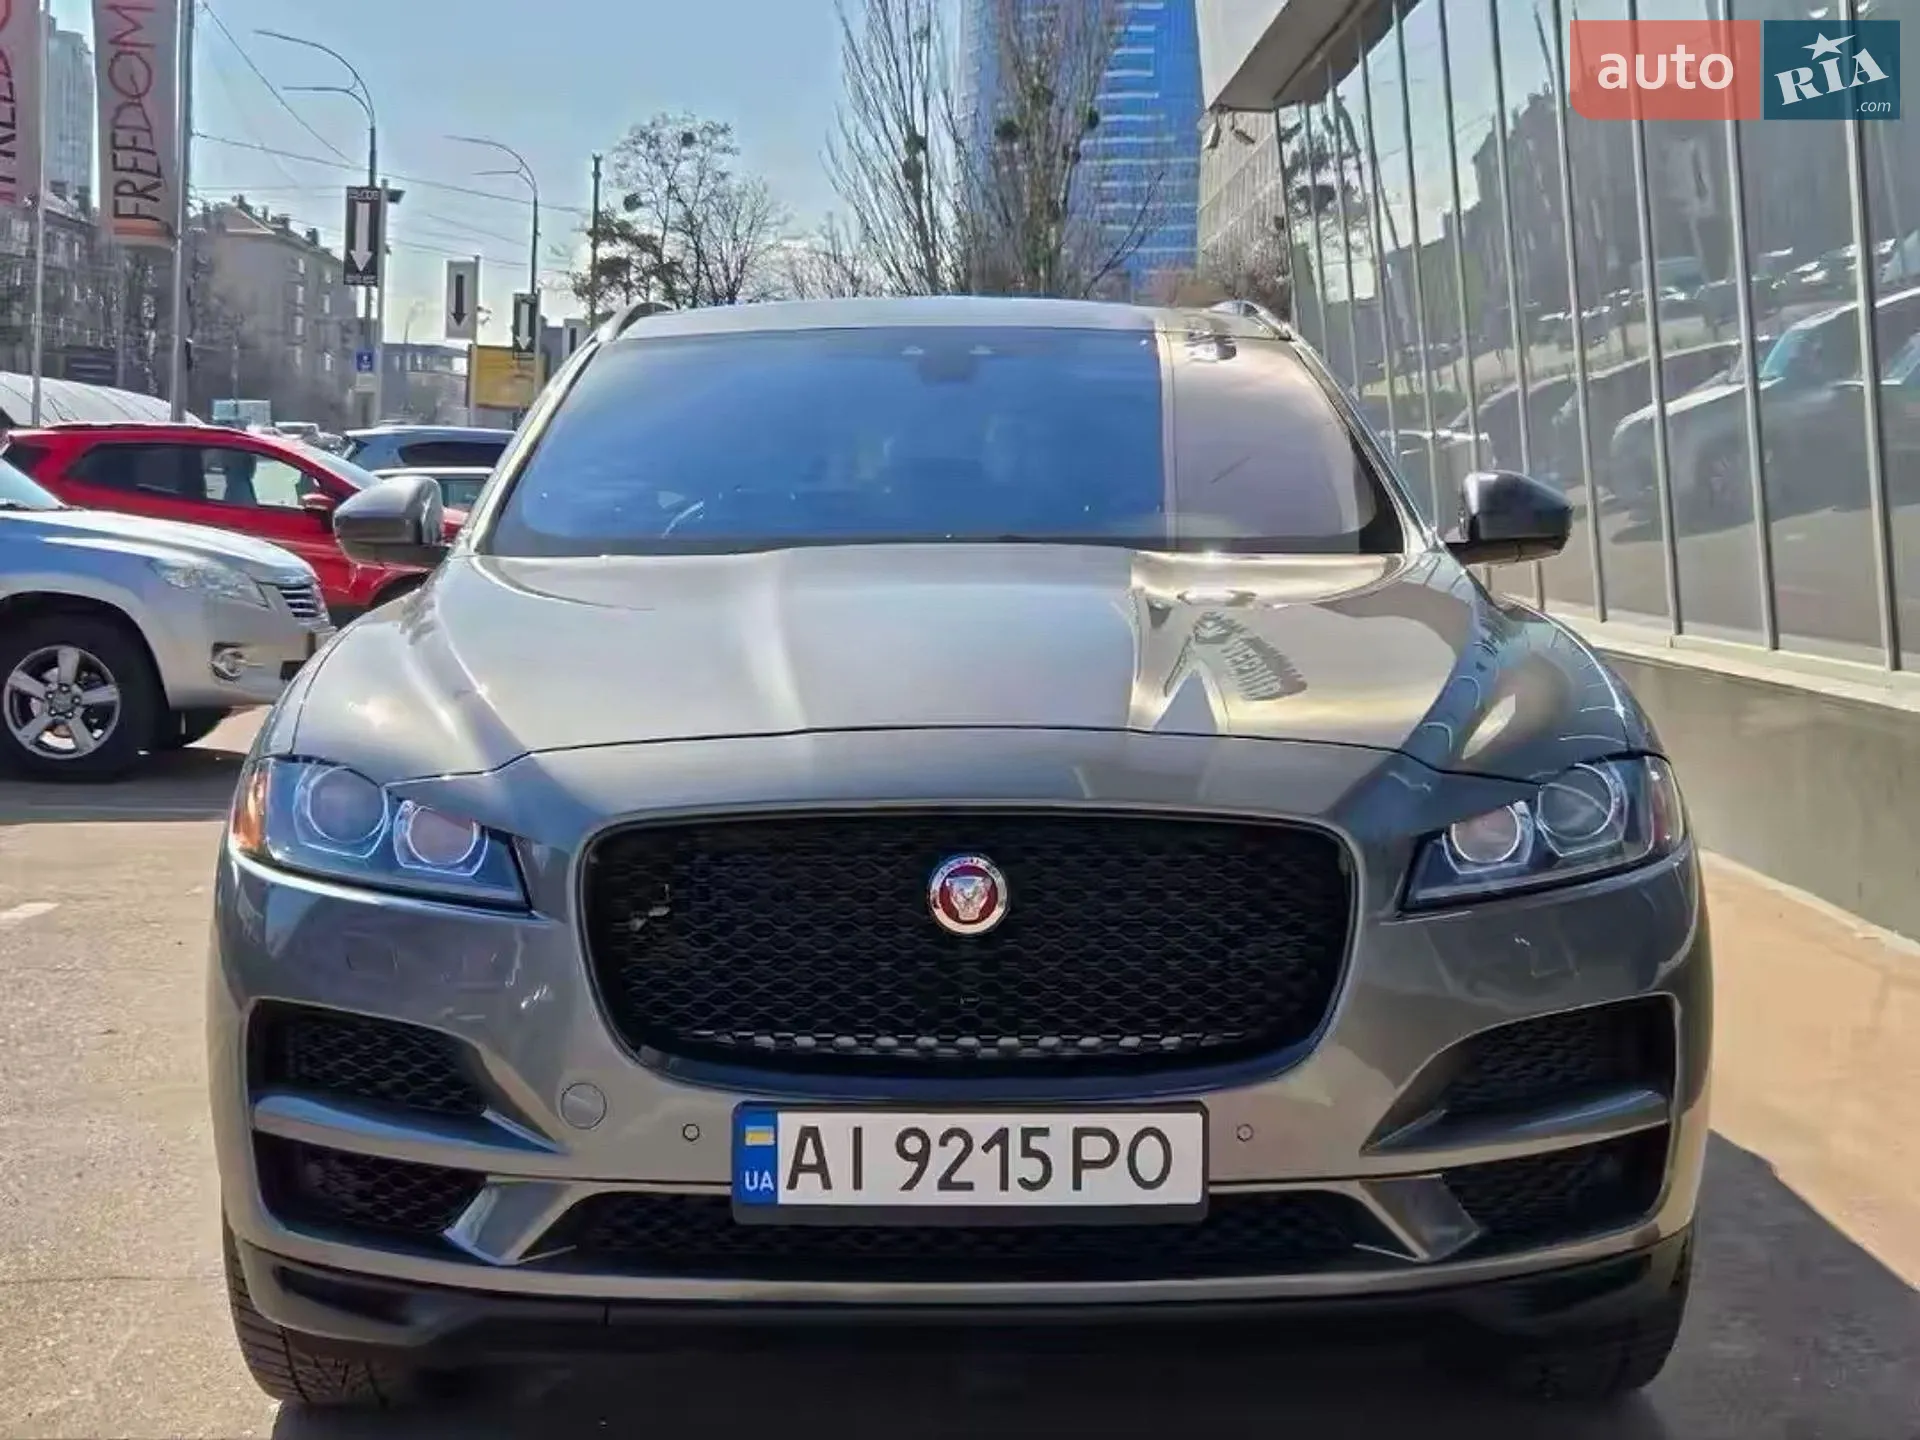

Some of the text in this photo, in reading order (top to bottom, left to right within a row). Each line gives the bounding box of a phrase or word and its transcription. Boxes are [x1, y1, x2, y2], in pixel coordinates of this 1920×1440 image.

[106, 4, 162, 222] FREEDOM
[744, 1169, 775, 1192] UA
[786, 1125, 1174, 1192] AI 9215 PO
